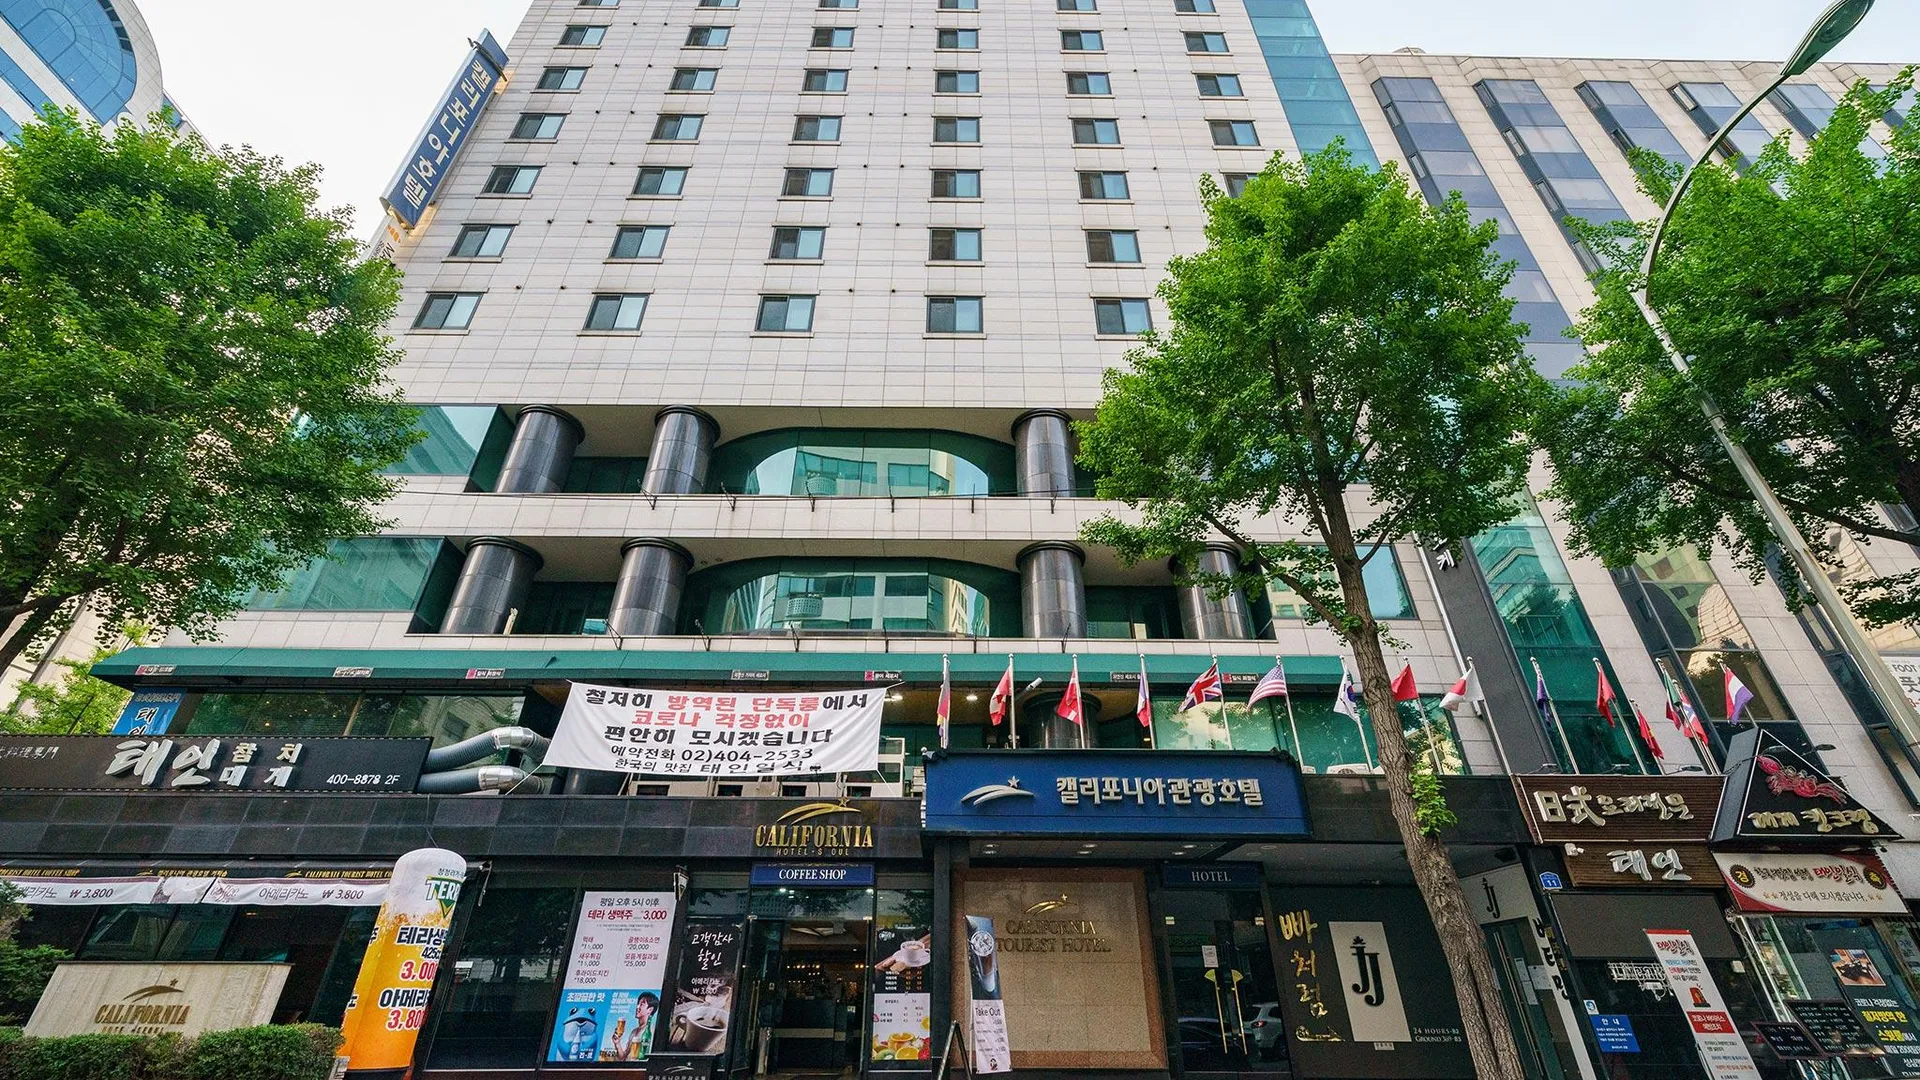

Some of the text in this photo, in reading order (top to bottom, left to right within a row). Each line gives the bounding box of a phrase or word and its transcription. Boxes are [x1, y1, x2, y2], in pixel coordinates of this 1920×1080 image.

[403, 60, 492, 209] 캘리포니아호텔
[1891, 664, 1917, 673] FOOT
[586, 688, 868, 712] 철저히 방역된 단독룸에서
[631, 710, 810, 729] 코로나 걱정없이
[604, 725, 834, 747] 편안히 모시겠습니다
[611, 745, 814, 762] 예약전화 02)404-2533
[105, 738, 221, 787] 태인
[615, 758, 657, 771] 한국의
[664, 762, 692, 773] 맛집
[384, 774, 400, 785] 2F
[1056, 777, 1264, 806] 캘리포니아관광호텔
[755, 824, 874, 848] CALIFORNIA
[1606, 848, 1692, 881] 태인
[779, 868, 847, 880] COFFEE SHOP
[1191, 871, 1232, 882] HOTEL
[425, 878, 461, 901] TERR
[1546, 879, 1557, 887] 11
[258, 887, 309, 900] 아메리카노
[600, 898, 660, 907] 평일 오후 5시 이후
[587, 909, 605, 920] 테라
[607, 909, 633, 920] 생맥주
[396, 926, 448, 946] 테라생
[1005, 920, 1097, 935] CALIFORNIA
[691, 932, 733, 947] 고객감사
[997, 938, 1111, 953] TOURIST HOTEL
[697, 948, 722, 970] 할인
[379, 989, 430, 1008] 아메리
[94, 1004, 191, 1025] CALIFORNIA
[975, 1007, 1001, 1017] Take Out
